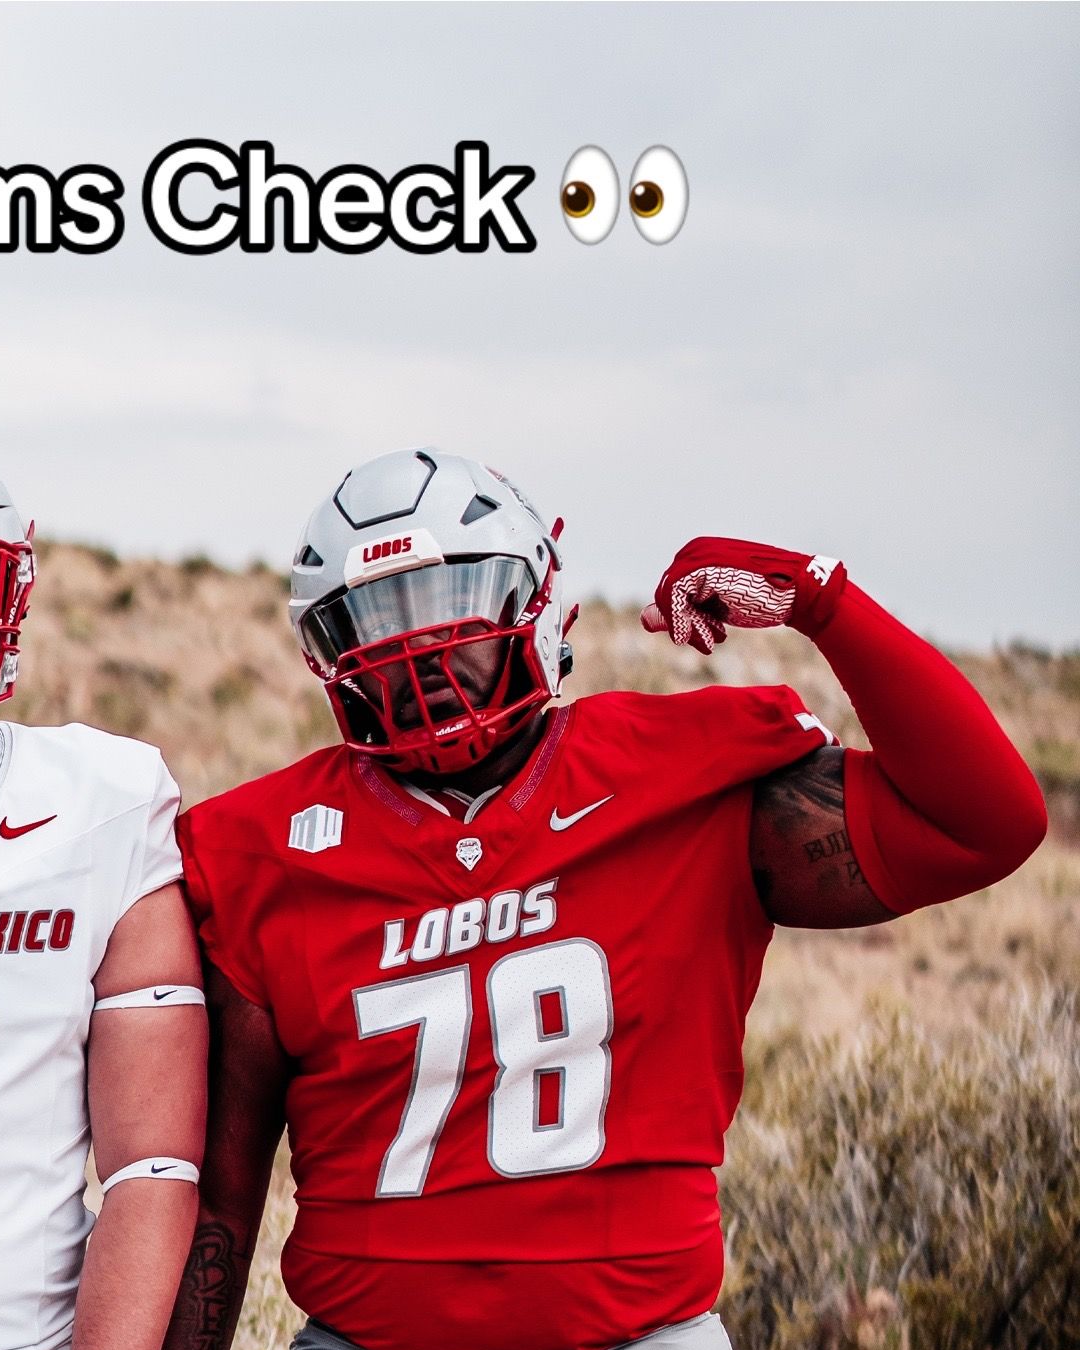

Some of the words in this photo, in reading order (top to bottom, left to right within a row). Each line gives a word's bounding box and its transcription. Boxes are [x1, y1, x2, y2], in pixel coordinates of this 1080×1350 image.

[363, 536, 412, 563] LOBOS
[379, 877, 559, 969] LOBOS
[351, 936, 614, 1199] 78
